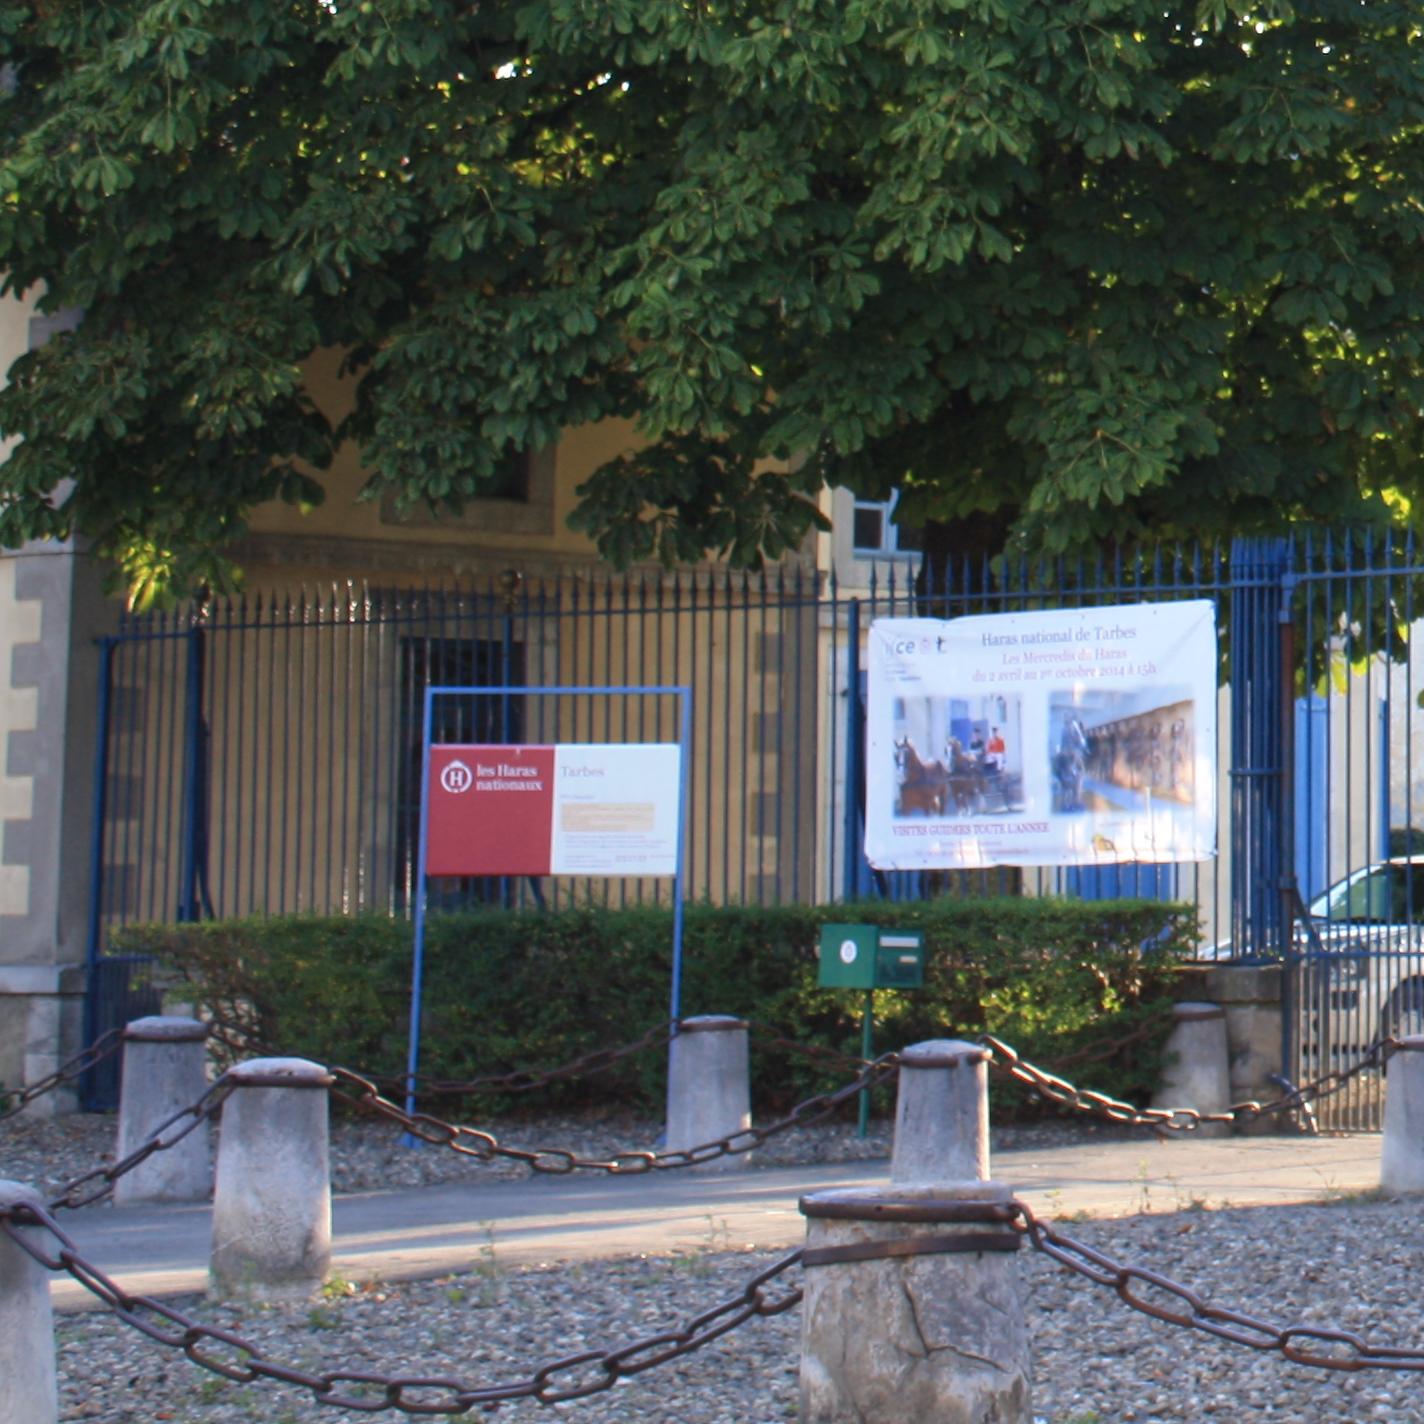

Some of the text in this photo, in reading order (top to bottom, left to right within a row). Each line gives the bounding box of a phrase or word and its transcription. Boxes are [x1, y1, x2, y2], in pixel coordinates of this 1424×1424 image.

[981, 625, 1137, 646] Haras national de Tarbes
[1002, 652, 1020, 665] Les
[1096, 647, 1127, 660] Haras
[1055, 665, 1096, 679] octobre
[477, 764, 537, 777] les Haras
[561, 766, 605, 777] Tarbes
[476, 779, 542, 791] nationaux
